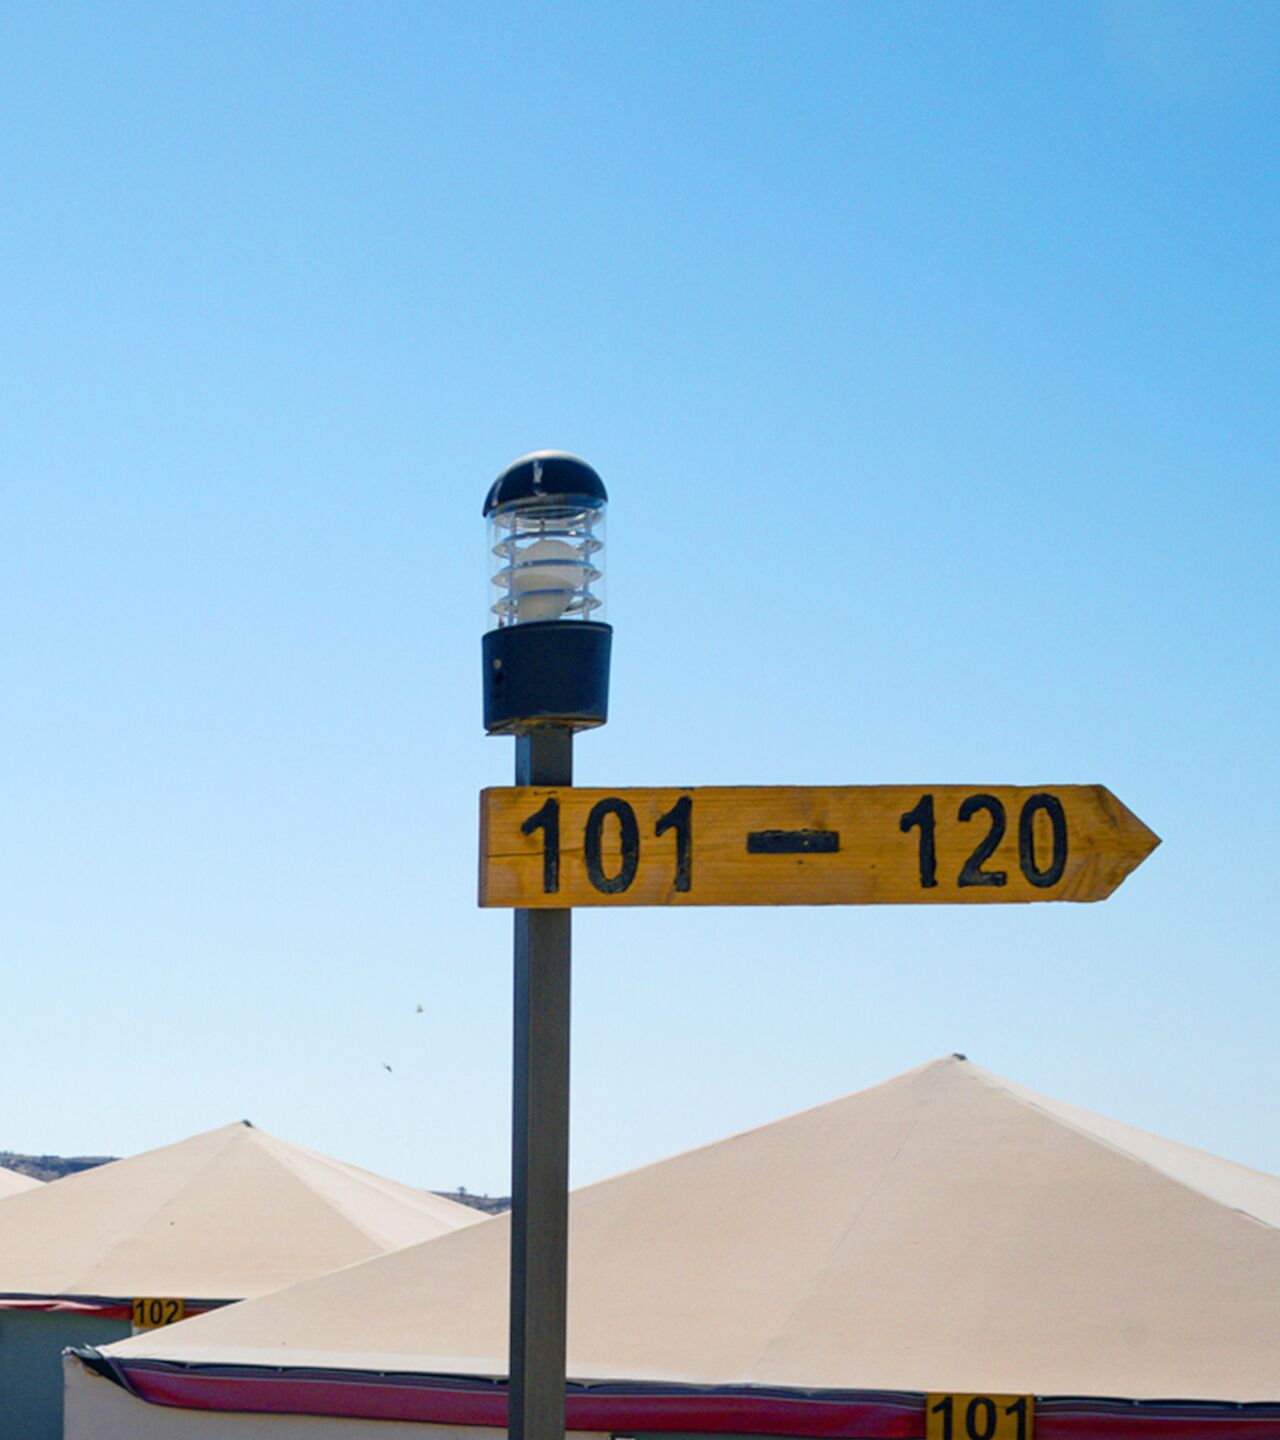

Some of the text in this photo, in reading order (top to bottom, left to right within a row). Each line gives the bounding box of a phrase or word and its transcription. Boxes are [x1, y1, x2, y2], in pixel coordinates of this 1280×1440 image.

[521, 797, 692, 893] 101
[899, 794, 1068, 888] 120
[135, 1299, 178, 1326] 102
